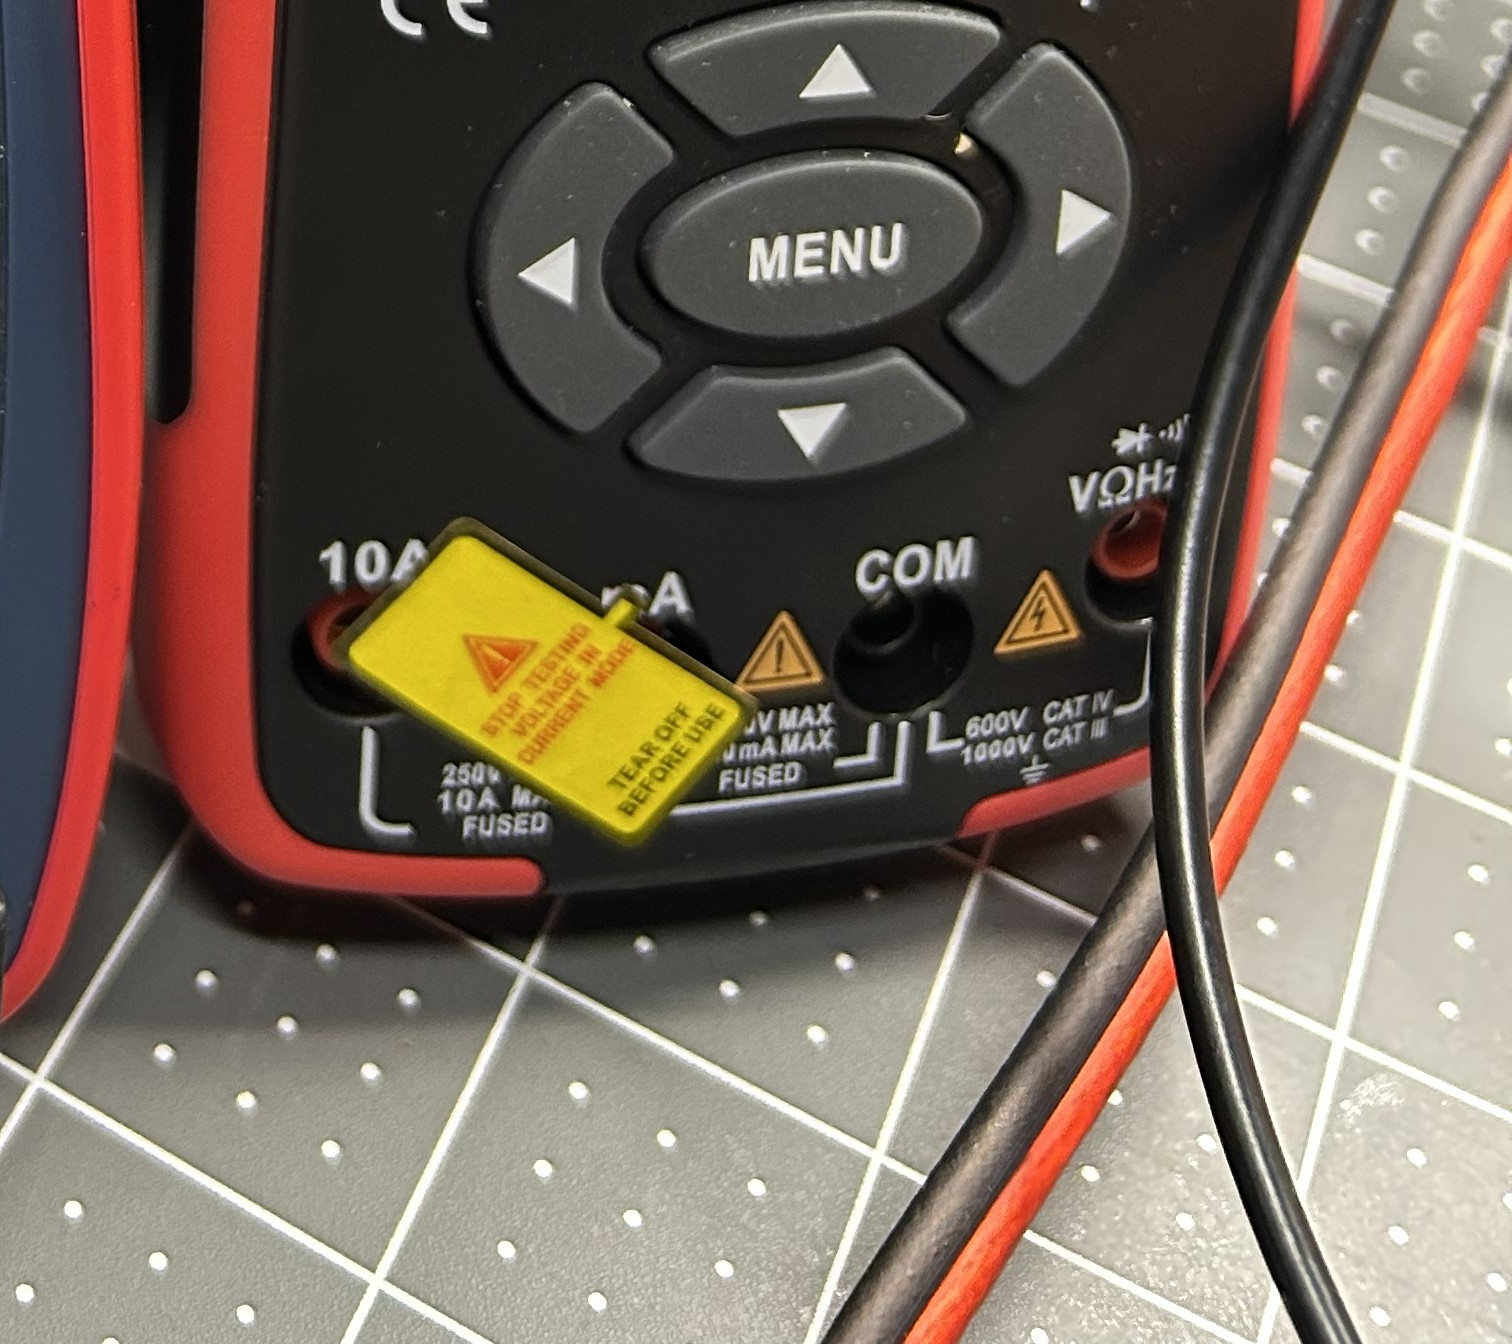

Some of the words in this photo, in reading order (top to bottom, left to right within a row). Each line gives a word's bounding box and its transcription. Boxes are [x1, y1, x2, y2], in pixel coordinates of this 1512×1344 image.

[748, 221, 905, 283] MENU
[319, 537, 429, 586] 10A
[854, 534, 979, 596] COM
[480, 690, 523, 739] STOP
[521, 621, 593, 692] TESTING
[510, 665, 581, 738] VOLTAGE
[516, 688, 593, 766] CURRENT
[587, 636, 636, 689] MODE
[778, 701, 836, 732] MAX
[965, 705, 1031, 739] 600V
[1042, 694, 1090, 726] CAT
[1092, 688, 1115, 713] IV
[606, 740, 662, 790] TEAR
[653, 701, 693, 742] OFF
[616, 742, 691, 818] BEFORE
[684, 702, 727, 744] USE
[780, 726, 837, 756] MAX
[960, 731, 1037, 766] 1000V
[1042, 720, 1089, 751] CAT
[437, 785, 501, 815] 10A
[718, 760, 804, 794] FUSED
[461, 811, 551, 841] FUSED
